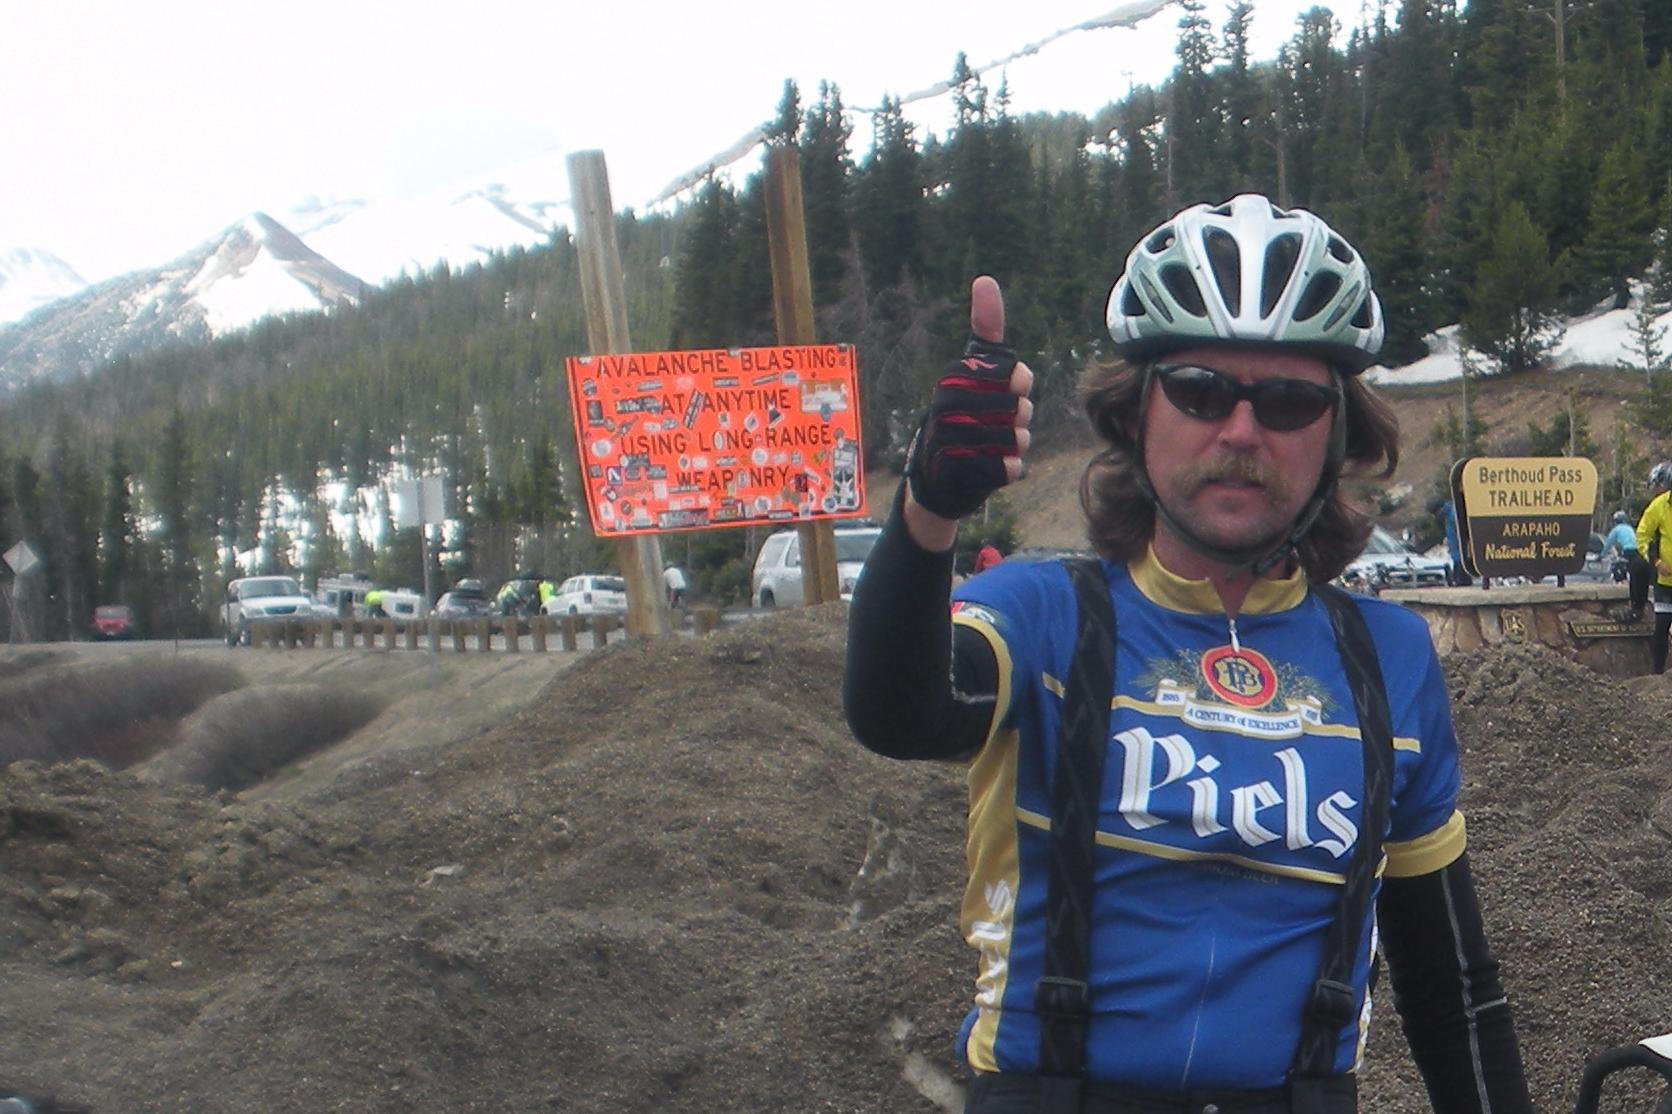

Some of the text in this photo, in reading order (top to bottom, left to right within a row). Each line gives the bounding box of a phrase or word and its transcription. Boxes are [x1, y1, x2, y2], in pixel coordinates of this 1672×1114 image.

[596, 348, 836, 378] AVALANCHE BLASTING
[660, 393, 689, 415] AT
[701, 388, 792, 412] ANYTIME
[621, 432, 687, 455] USING
[765, 424, 832, 448] RANGE
[1479, 465, 1583, 484] Berthoud Pass
[1489, 490, 1575, 507] TRAILHEAD
[1503, 521, 1561, 537] ARAPAHO
[1485, 542, 1576, 560] National Forest
[1186, 707, 1194, 718] A
[1194, 709, 1236, 726] CENTURY
[1247, 717, 1299, 731] EXCELLENCE
[1112, 726, 1359, 858] Piels
